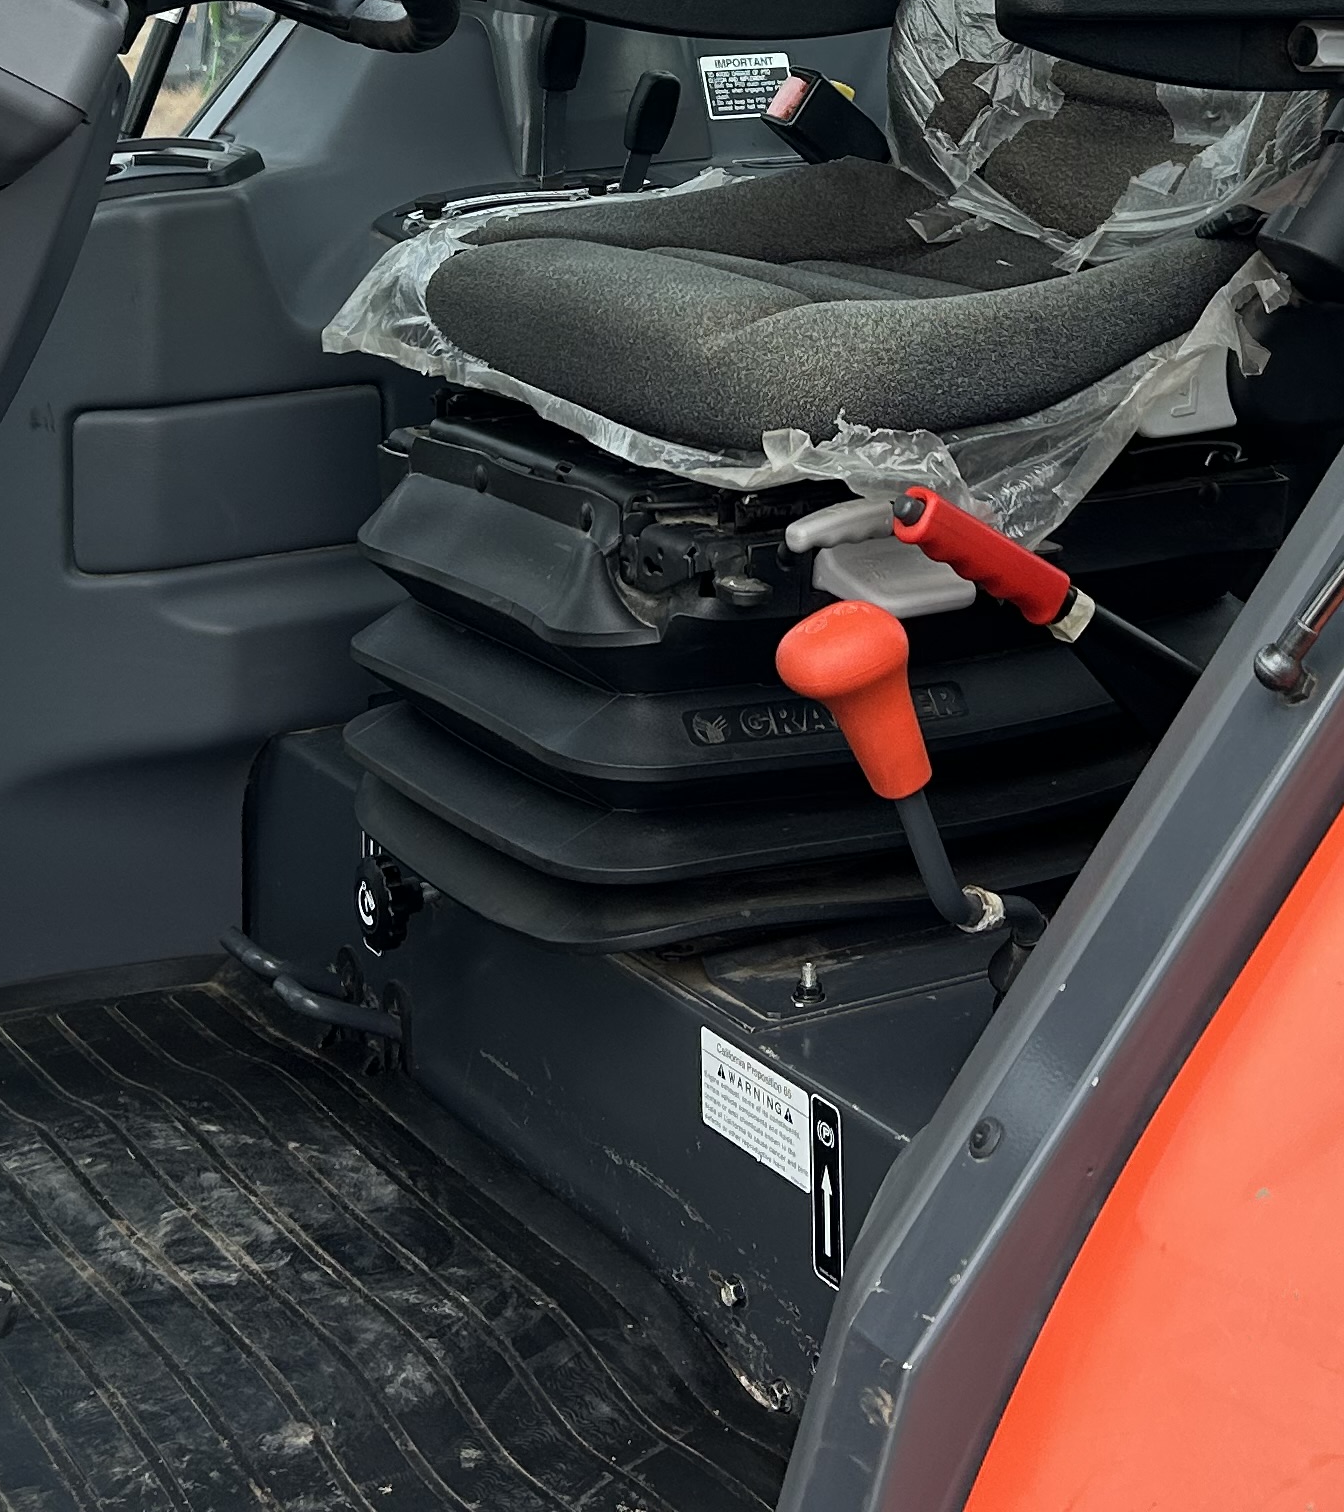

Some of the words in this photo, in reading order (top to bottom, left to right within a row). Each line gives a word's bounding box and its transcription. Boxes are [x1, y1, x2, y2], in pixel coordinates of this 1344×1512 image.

[714, 57, 773, 68] IMPORTANT
[739, 688, 958, 737] GRAER
[728, 1069, 782, 1116] WARNING
